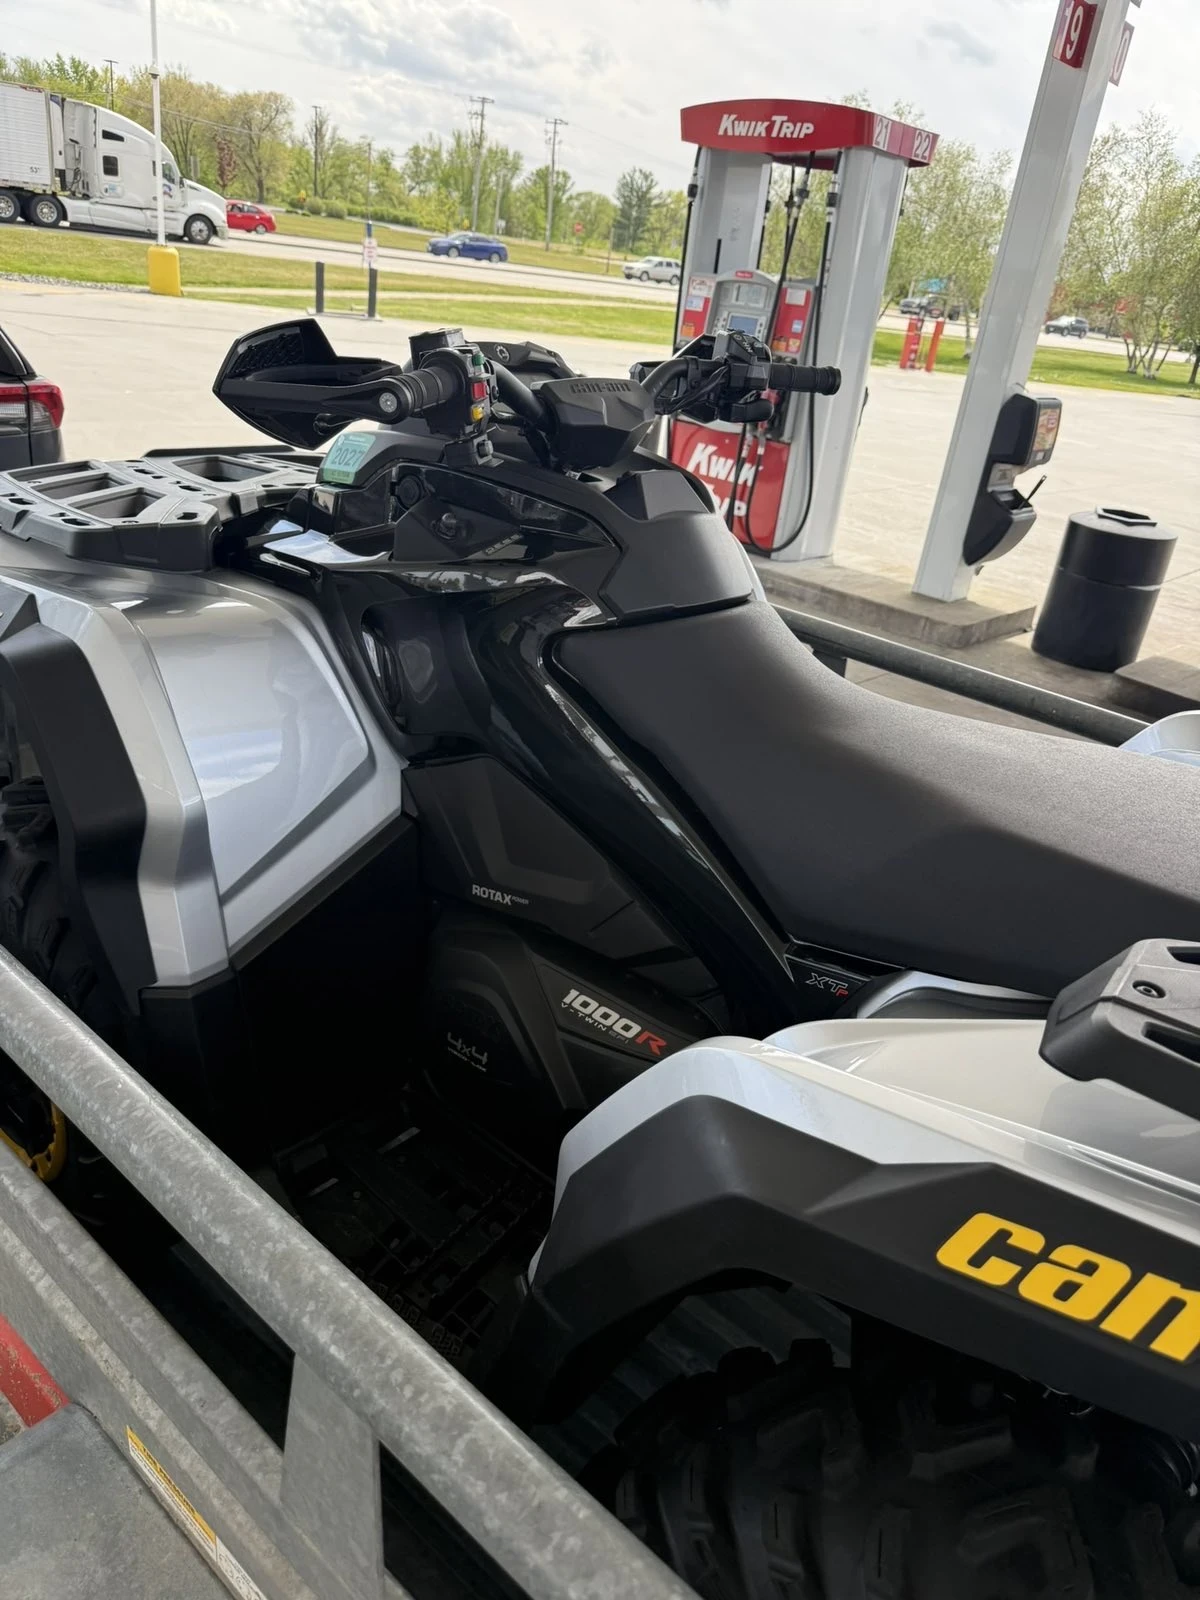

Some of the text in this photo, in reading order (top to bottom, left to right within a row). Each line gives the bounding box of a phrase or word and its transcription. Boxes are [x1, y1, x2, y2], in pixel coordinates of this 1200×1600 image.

[1057, 0, 1084, 60] 19
[771, 115, 815, 139] TRIP
[874, 117, 891, 149] 21
[913, 130, 931, 159] 22
[330, 446, 367, 468] 2027
[472, 884, 512, 906] ROTAX
[561, 1002, 607, 1032] V-TWIN
[562, 988, 667, 1056] 1000R
